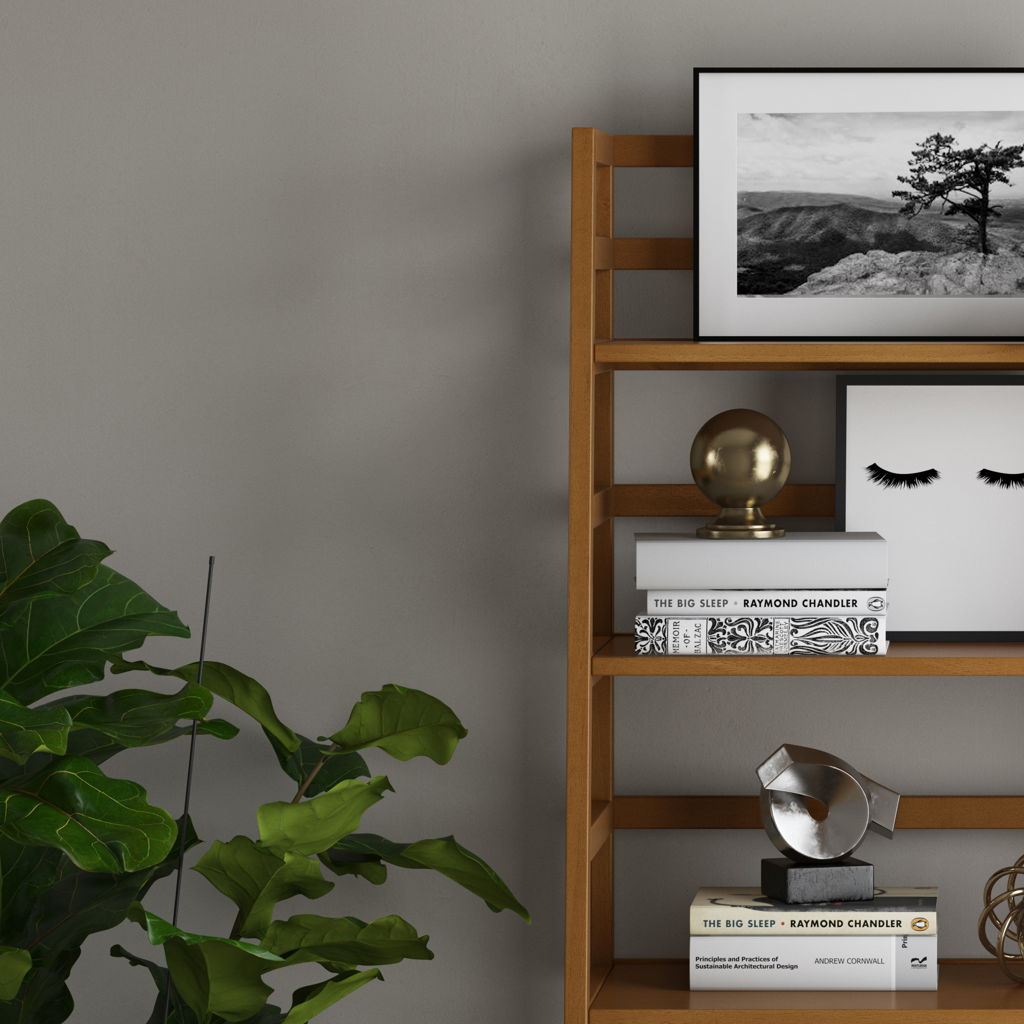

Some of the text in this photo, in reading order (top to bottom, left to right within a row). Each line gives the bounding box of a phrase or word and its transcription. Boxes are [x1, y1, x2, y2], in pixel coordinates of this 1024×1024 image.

[654, 599, 858, 608] THE BIG SLEEP RAYMOND CHANDLER
[703, 920, 902, 928] THE BIG SLEEP RAYMOND CHANDLER
